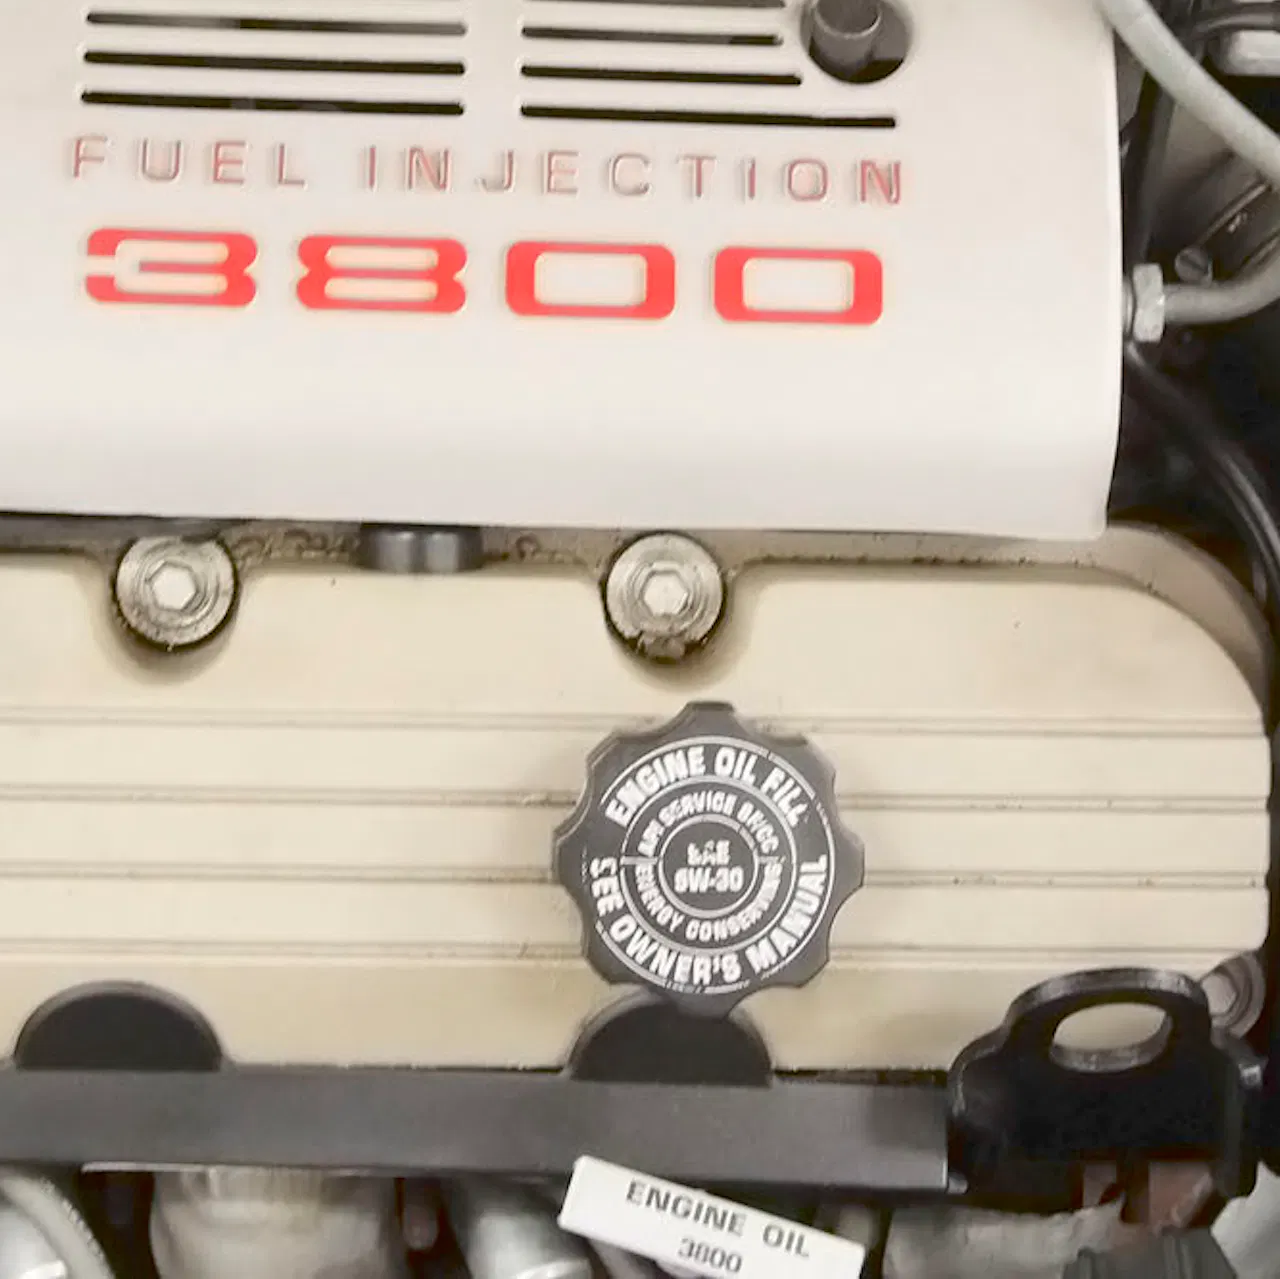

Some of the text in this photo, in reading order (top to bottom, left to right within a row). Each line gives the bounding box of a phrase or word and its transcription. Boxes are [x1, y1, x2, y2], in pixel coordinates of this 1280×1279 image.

[72, 134, 902, 205] FUEL INJECTION
[86, 228, 882, 324] 3800
[605, 745, 810, 829] ENGINE OIL FILL
[590, 854, 828, 985] SEE OWNER'S MANUAL
[635, 863, 685, 933] ENERGY
[625, 1180, 810, 1258] ENGINE OIL
[678, 1237, 742, 1273] 3800
